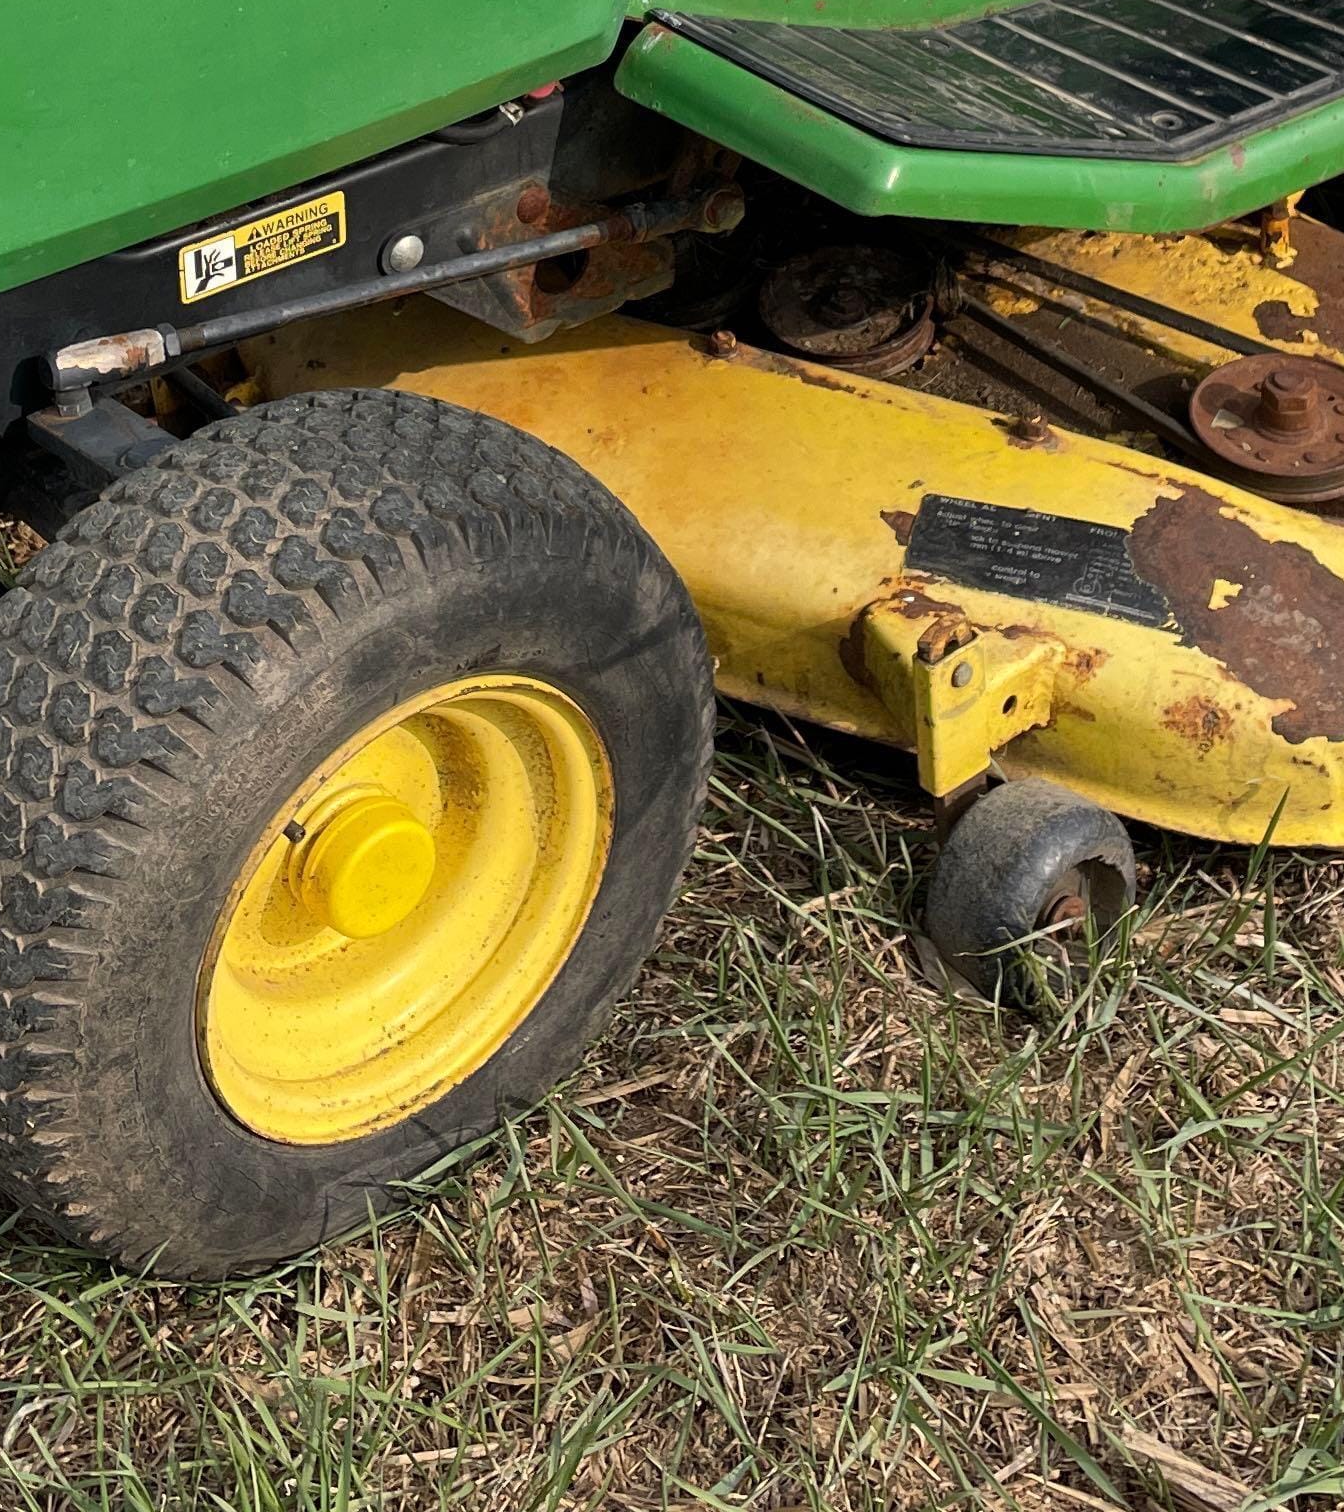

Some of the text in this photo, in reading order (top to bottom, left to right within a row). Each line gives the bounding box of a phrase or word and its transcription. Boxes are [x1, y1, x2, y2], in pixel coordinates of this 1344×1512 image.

[261, 202, 329, 235] WARNING
[249, 218, 328, 254] LOADED SPRING
[991, 565, 1027, 576] control
[1029, 570, 1041, 579] to
